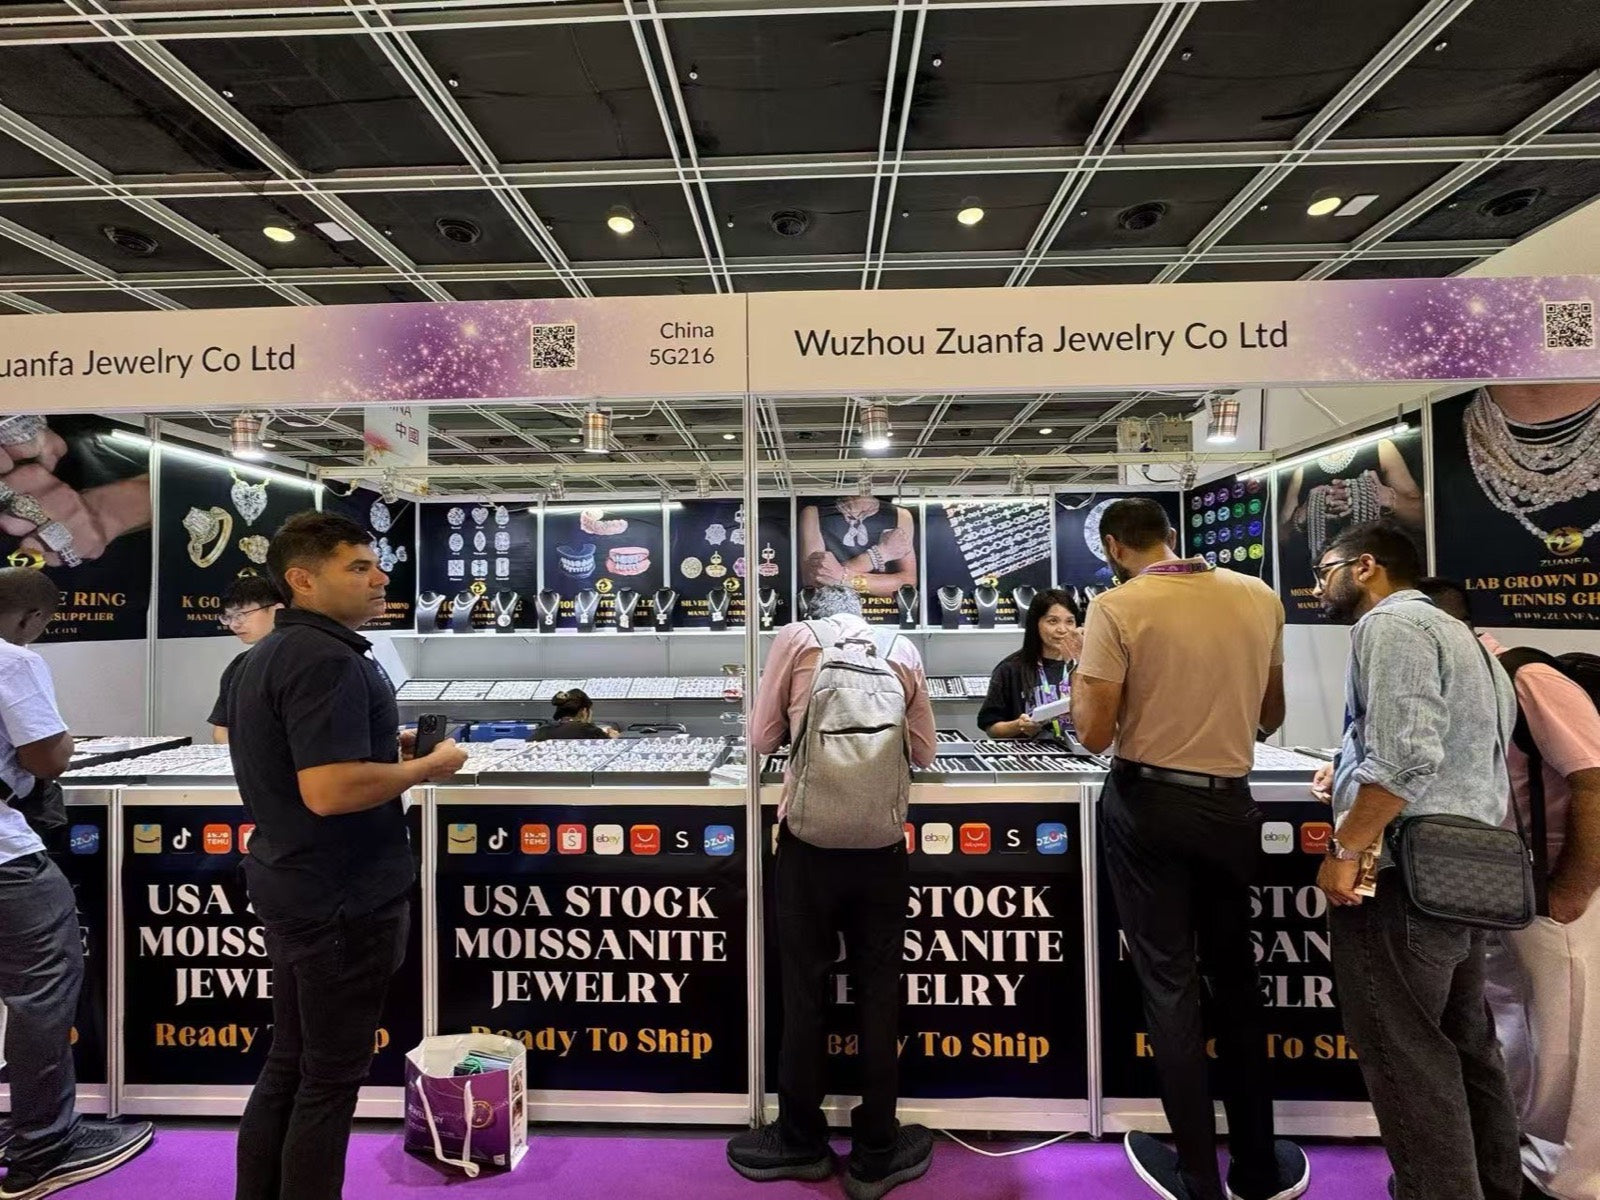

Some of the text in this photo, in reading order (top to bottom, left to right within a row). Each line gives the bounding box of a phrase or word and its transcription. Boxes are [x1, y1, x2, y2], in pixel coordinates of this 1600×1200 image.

[661, 322, 714, 340] China
[795, 320, 1288, 357] Wuzhou Zuanfa Jewelry Co Ltd
[0, 344, 295, 378] uanfa Jewelry Co Ltd
[650, 348, 714, 366] 5G216
[1540, 557, 1591, 567] ZUANFA
[1465, 572, 1600, 590] LAB GROWN D
[74, 592, 126, 606] RING
[182, 595, 220, 609] K GO
[1500, 592, 1567, 606] TENNIS
[1514, 612, 1600, 621] WWW.ZUANFA.
[207, 838, 229, 846] TEMU
[524, 838, 548, 846] TEMU
[596, 834, 620, 845] ebay
[675, 831, 689, 849] S
[924, 834, 950, 844] ebay
[1007, 829, 1021, 847] S
[1264, 832, 1291, 843] ebay
[148, 884, 233, 915] USA
[463, 885, 719, 919] USA STOCK
[139, 926, 268, 957] MOISS
[455, 927, 727, 962] MOISSANITE
[176, 968, 273, 1006] JEWE
[491, 970, 690, 1009] JEWELRY
[156, 1023, 259, 1053] Ready
[586, 1028, 628, 1052] To
[638, 1029, 713, 1060] Ship
[1314, 1034, 1359, 1060] Sh
[918, 1031, 962, 1057] To
[972, 1032, 1050, 1064] Ship
